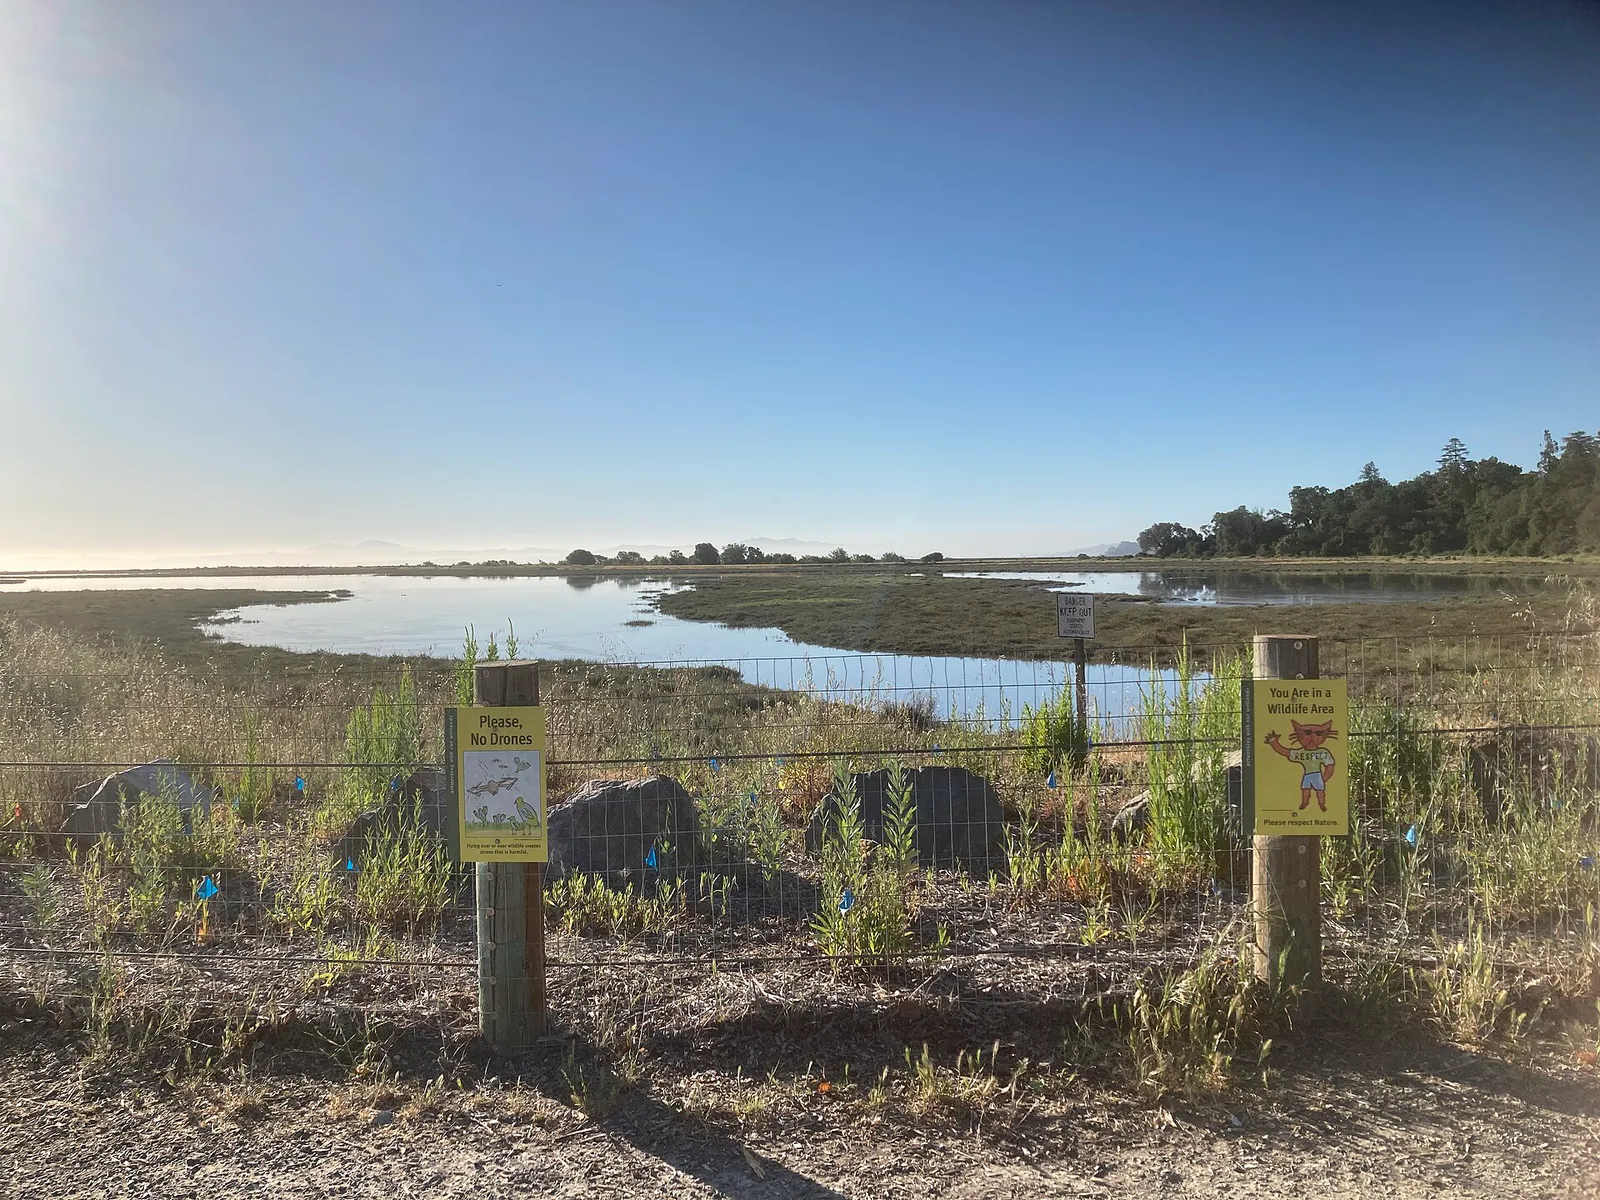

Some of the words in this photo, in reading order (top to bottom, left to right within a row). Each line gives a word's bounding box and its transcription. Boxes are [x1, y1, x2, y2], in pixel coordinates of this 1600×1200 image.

[1065, 596, 1086, 605] DANGER
[1060, 607, 1076, 616] KEEP
[1079, 607, 1092, 616] OUT
[1269, 688, 1289, 698] You
[1292, 688, 1309, 698] Are
[1312, 687, 1322, 698] in
[1325, 689, 1331, 698] a
[1267, 703, 1308, 714] Wildlife
[1310, 704, 1334, 714] Area
[480, 715, 523, 730] Please,
[470, 732, 487, 746] No
[490, 732, 533, 746] Drones
[1294, 751, 1328, 761] RESPECT
